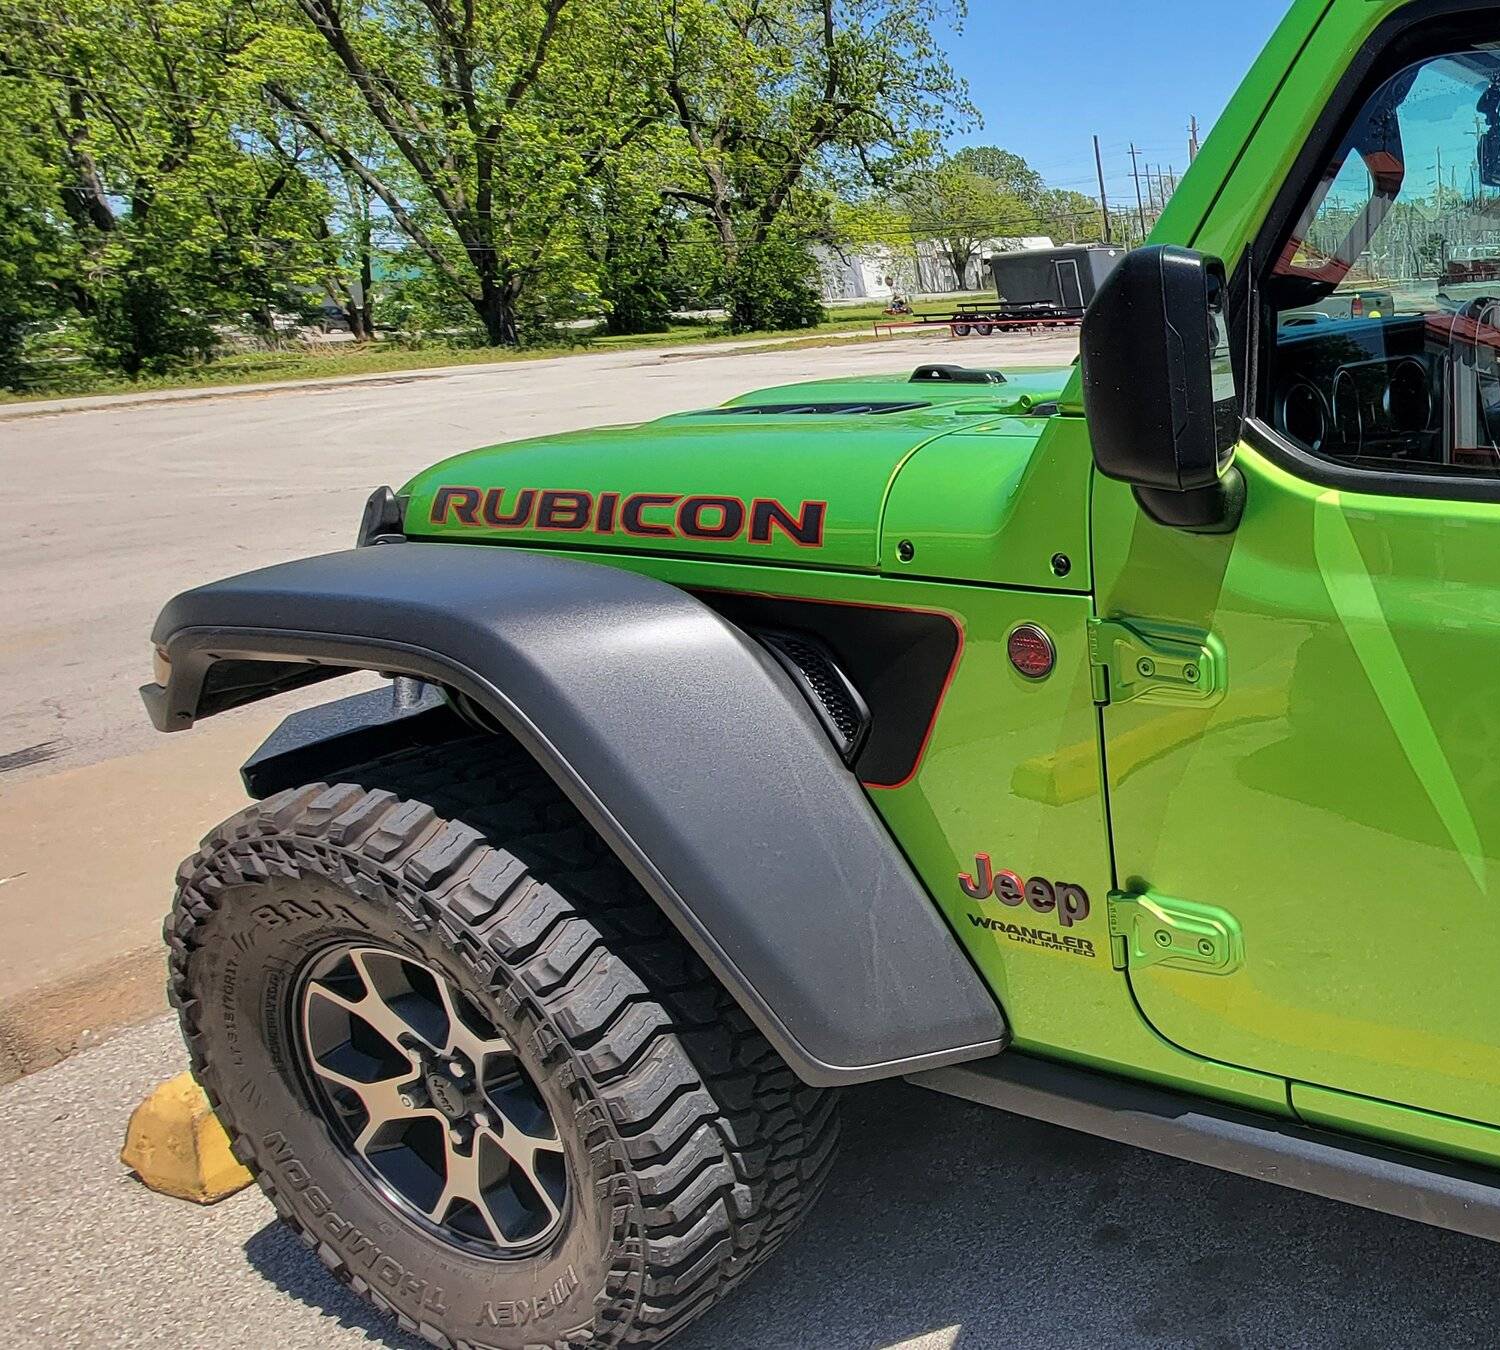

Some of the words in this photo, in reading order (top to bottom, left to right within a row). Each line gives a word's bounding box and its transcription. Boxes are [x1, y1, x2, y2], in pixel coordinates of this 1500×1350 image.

[430, 484, 827, 548] RUBICON
[957, 851, 1090, 927] Jeep
[250, 899, 370, 932] BAJA
[967, 912, 1095, 952] WRANGLER
[1008, 934, 1096, 958] UNLIMITED
[433, 1079, 456, 1113] Jeep
[262, 1129, 449, 1318] THOMPSON
